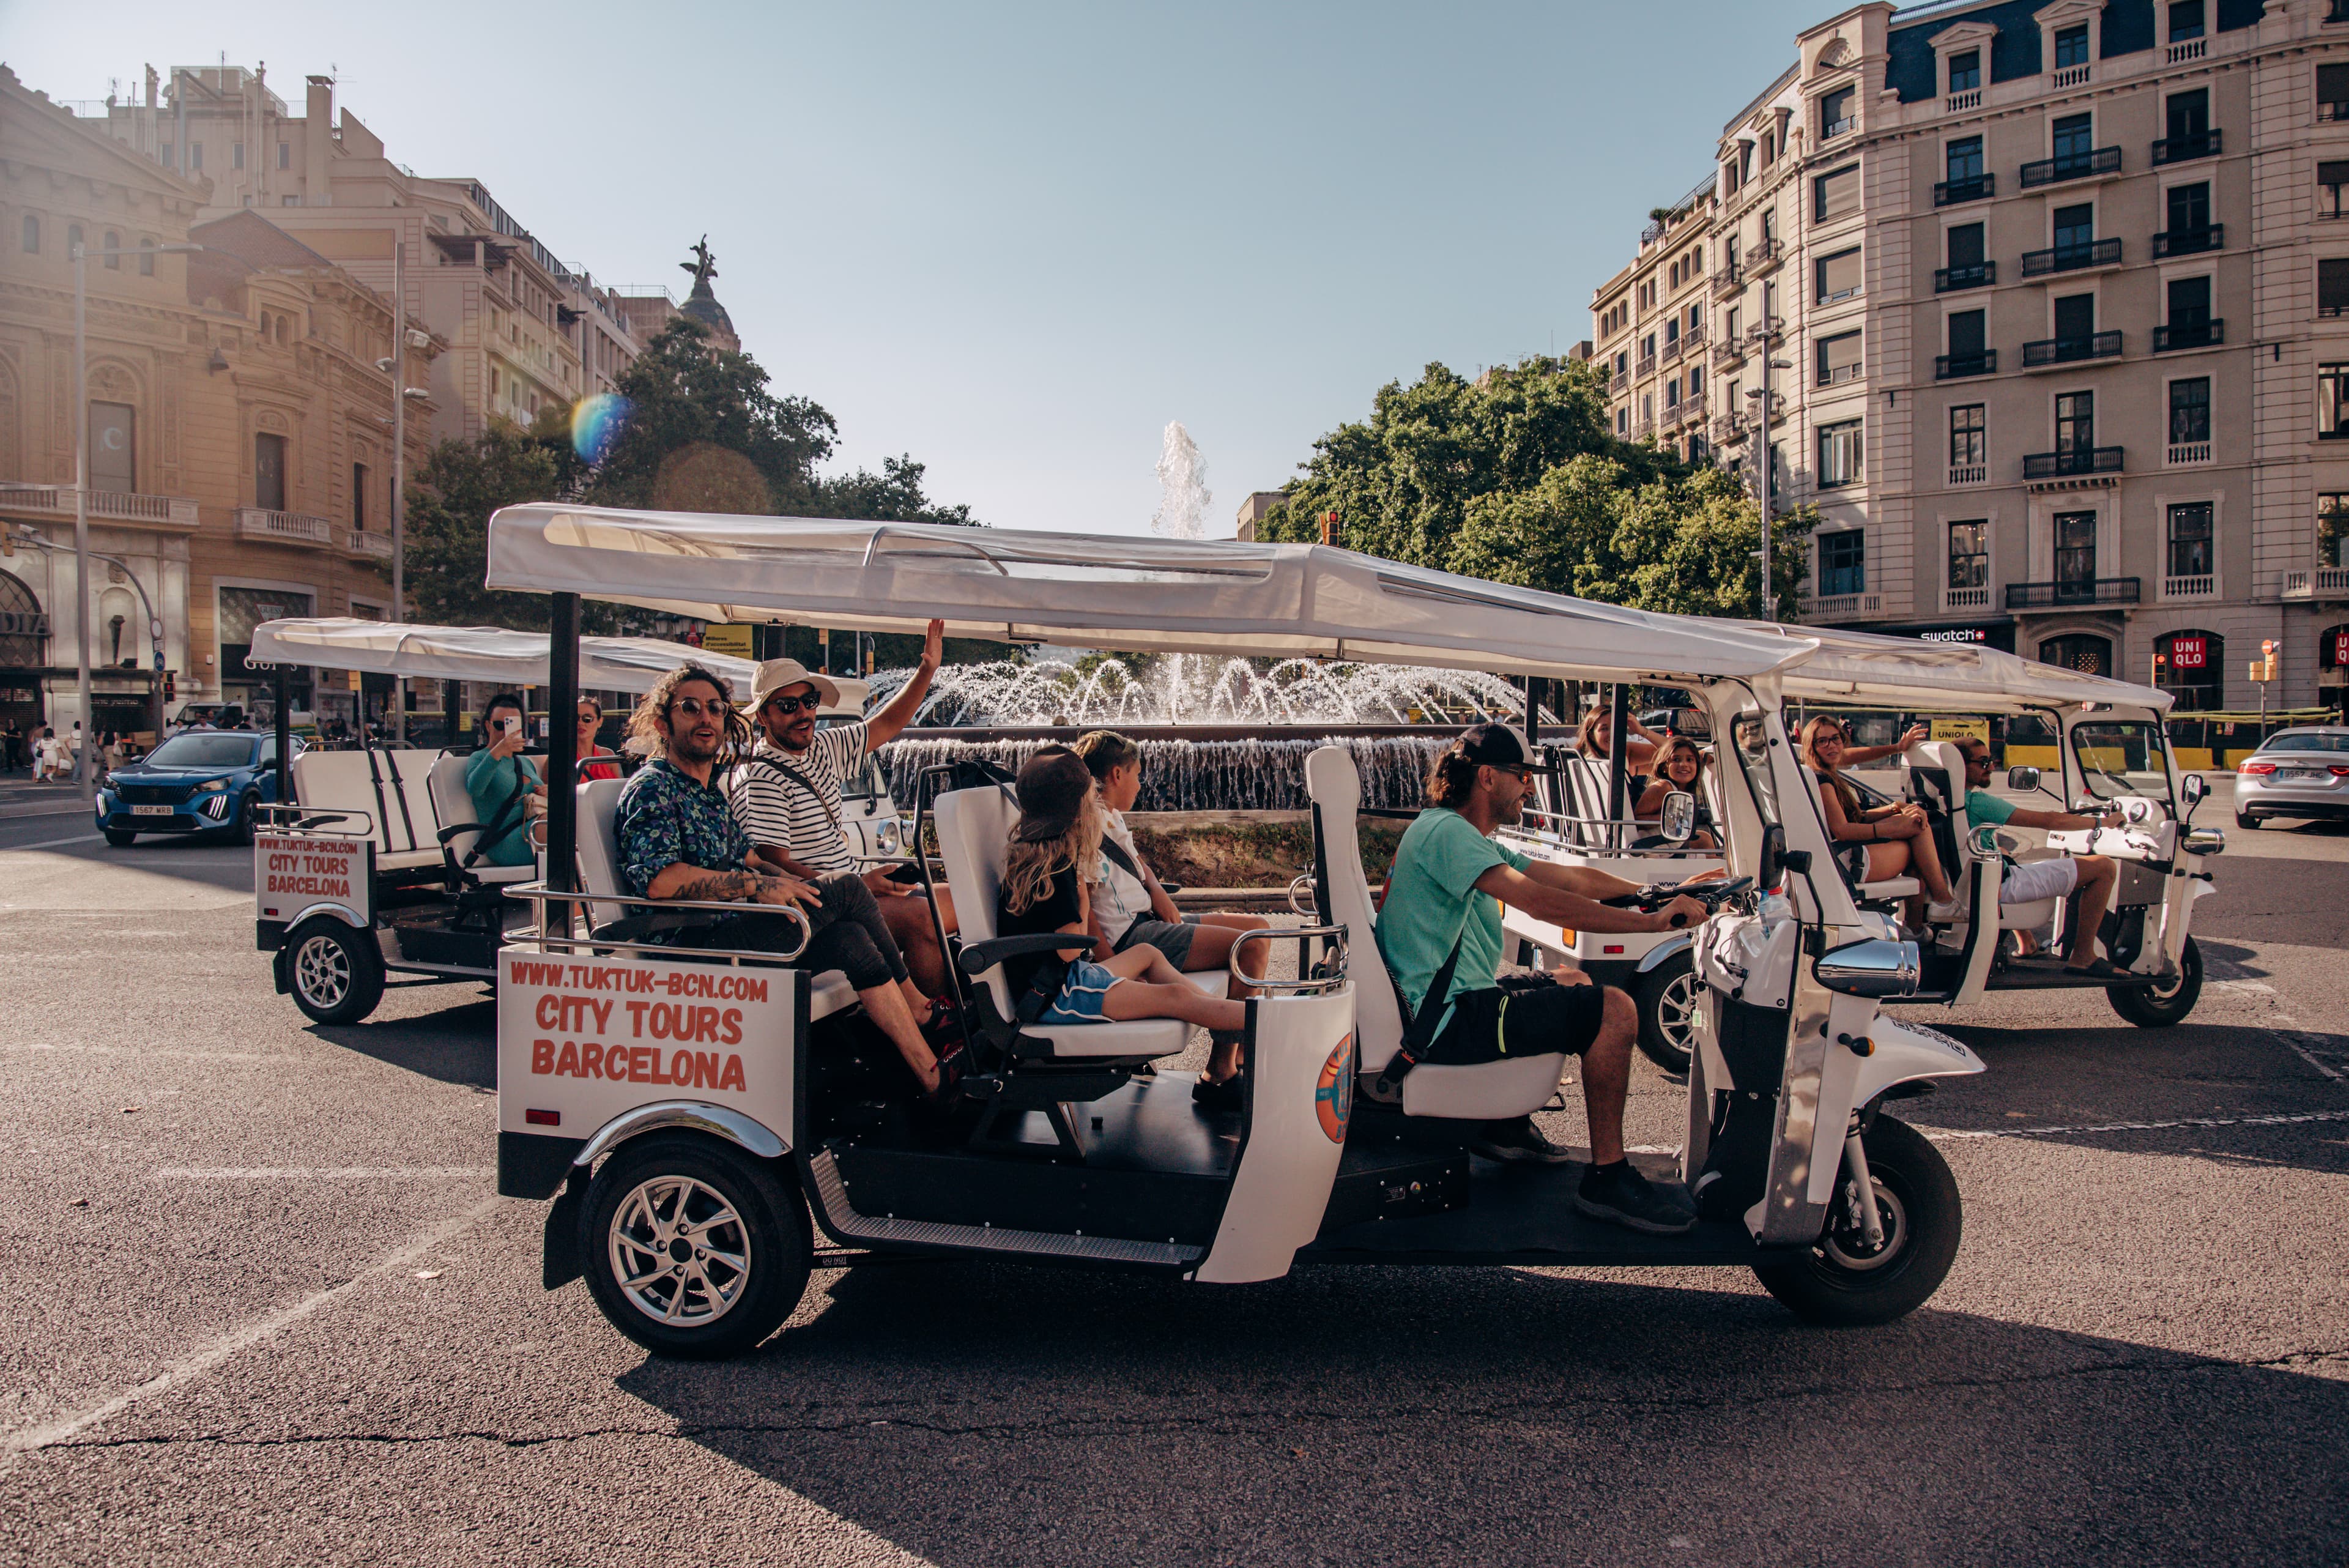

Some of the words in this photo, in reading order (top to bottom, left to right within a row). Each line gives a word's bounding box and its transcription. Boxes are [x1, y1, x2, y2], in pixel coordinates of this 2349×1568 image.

[1921, 629, 1975, 642] swatch
[2175, 641, 2200, 652] UNI
[2175, 653, 2202, 666] QLO
[259, 838, 358, 855] WWW.TUKTUK-BCN.COM
[269, 854, 299, 872] CITY
[303, 856, 349, 875] TOURS
[268, 875, 351, 898] BARCELONA
[511, 962, 768, 1003] WWW.TUKTUK-BCN.COM
[535, 994, 614, 1035] CITY
[626, 1001, 743, 1045] TOURS
[532, 1039, 746, 1091] BARCELONA
